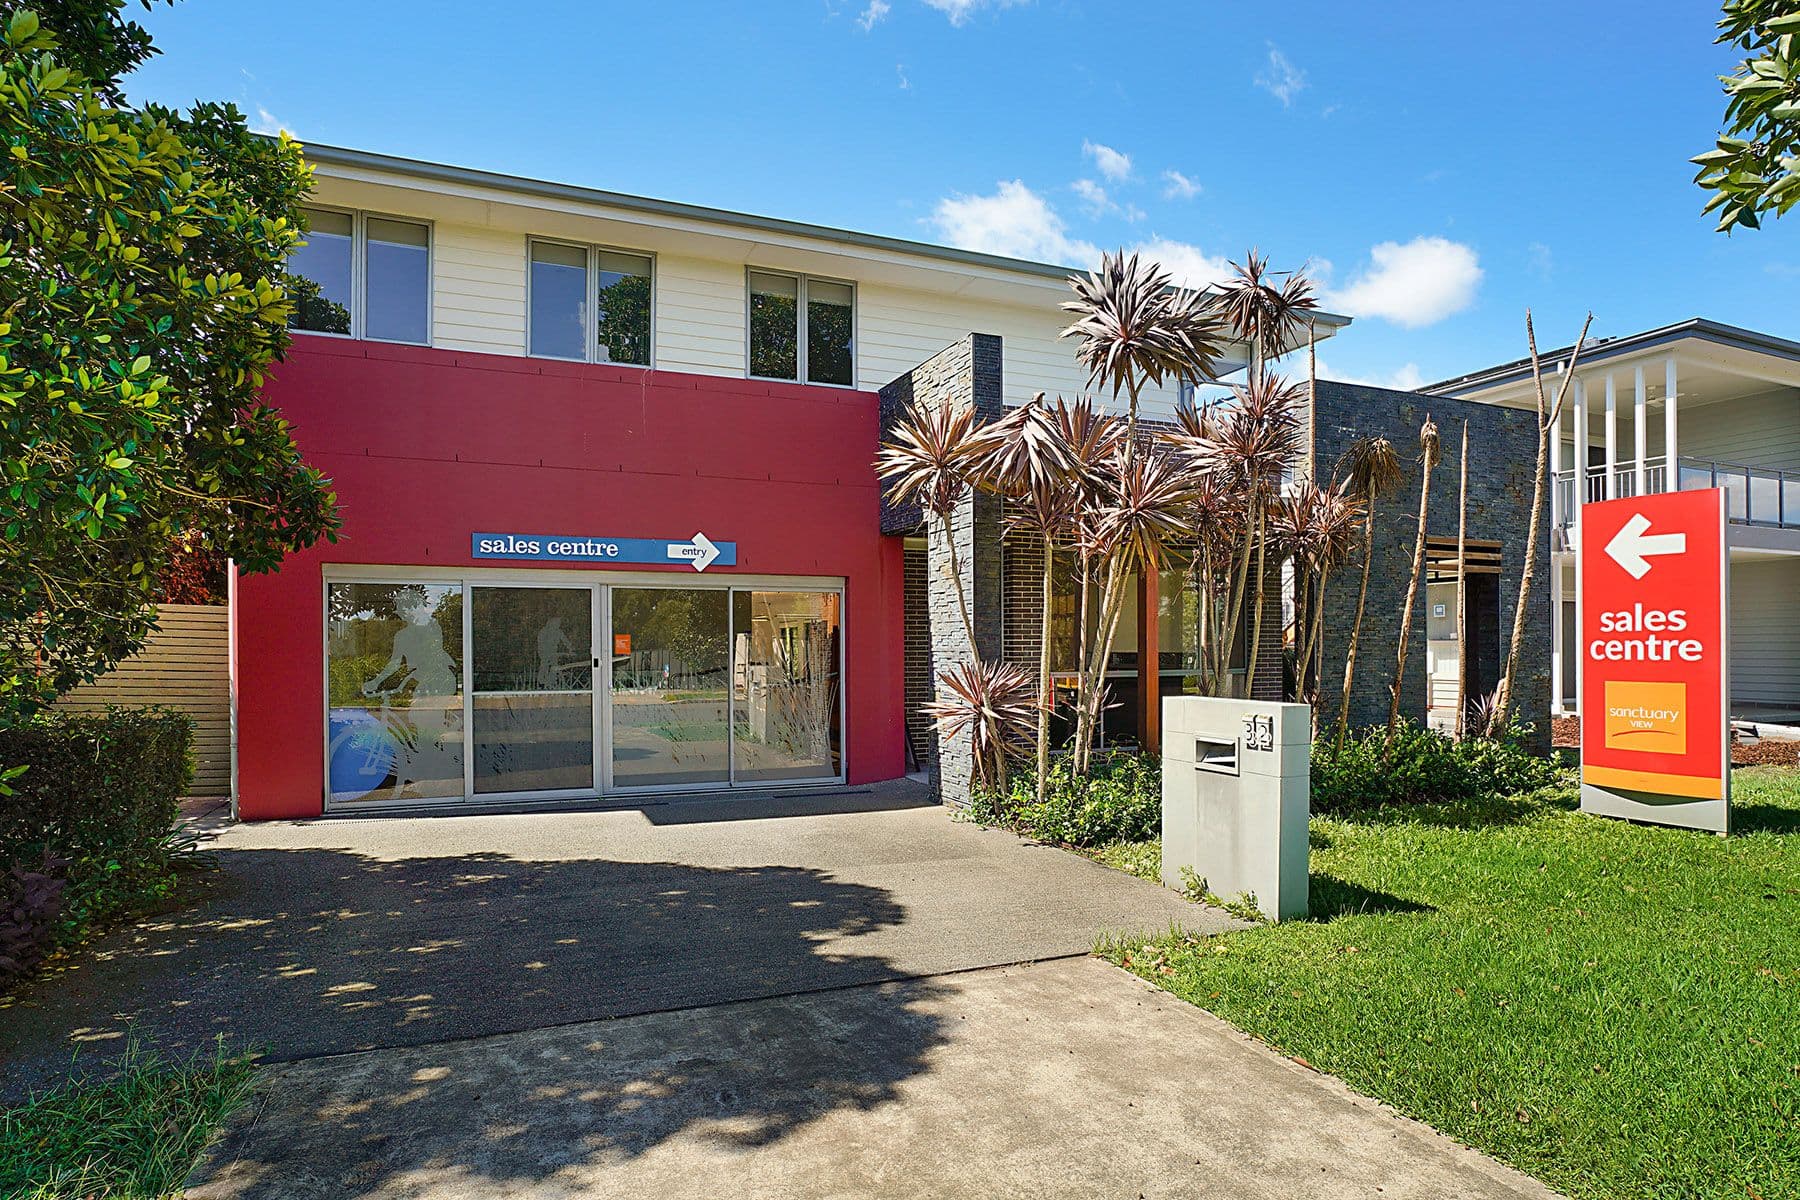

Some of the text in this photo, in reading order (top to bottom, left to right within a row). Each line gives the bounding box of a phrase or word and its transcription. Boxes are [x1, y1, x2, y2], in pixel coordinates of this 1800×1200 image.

[480, 536, 619, 557] sales centre
[681, 547, 707, 558] entry
[1600, 602, 1687, 632] sales
[1589, 634, 1703, 661] centre
[1609, 707, 1680, 722] sanctuary
[1629, 720, 1654, 729] VIEW
